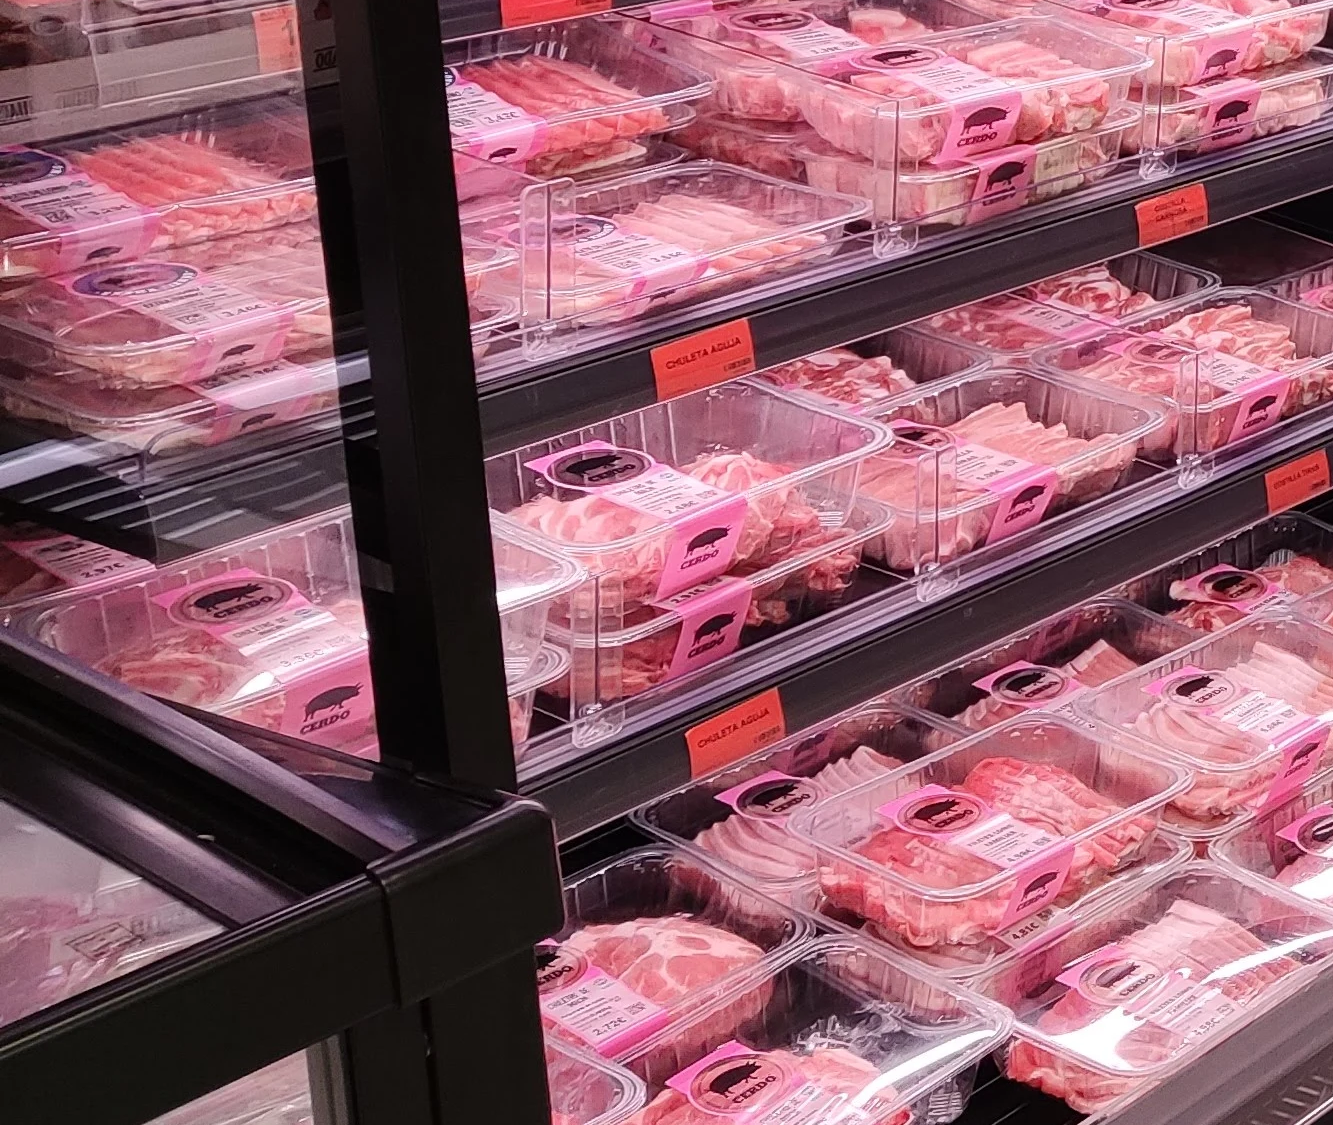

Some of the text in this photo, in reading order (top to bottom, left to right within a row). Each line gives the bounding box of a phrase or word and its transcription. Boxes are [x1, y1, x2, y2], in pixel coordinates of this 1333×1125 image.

[957, 131, 998, 148] CERDO
[665, 347, 709, 370] CHULETA
[711, 336, 742, 355] AGUJA
[588, 463, 636, 483] CERDO
[1004, 504, 1036, 524] CERDO
[680, 549, 720, 571] CERDO
[213, 595, 275, 619] CERDO
[687, 636, 727, 659] CERDO
[300, 709, 351, 736] CERDO
[697, 706, 771, 750] CHULETA AGUJA
[772, 792, 811, 814] CERDO
[934, 809, 975, 829] CERDO
[1015, 889, 1049, 913] CERDO
[537, 964, 575, 986] ERDO
[1119, 972, 1157, 997] CERDO
[732, 1074, 778, 1105] CERDO
